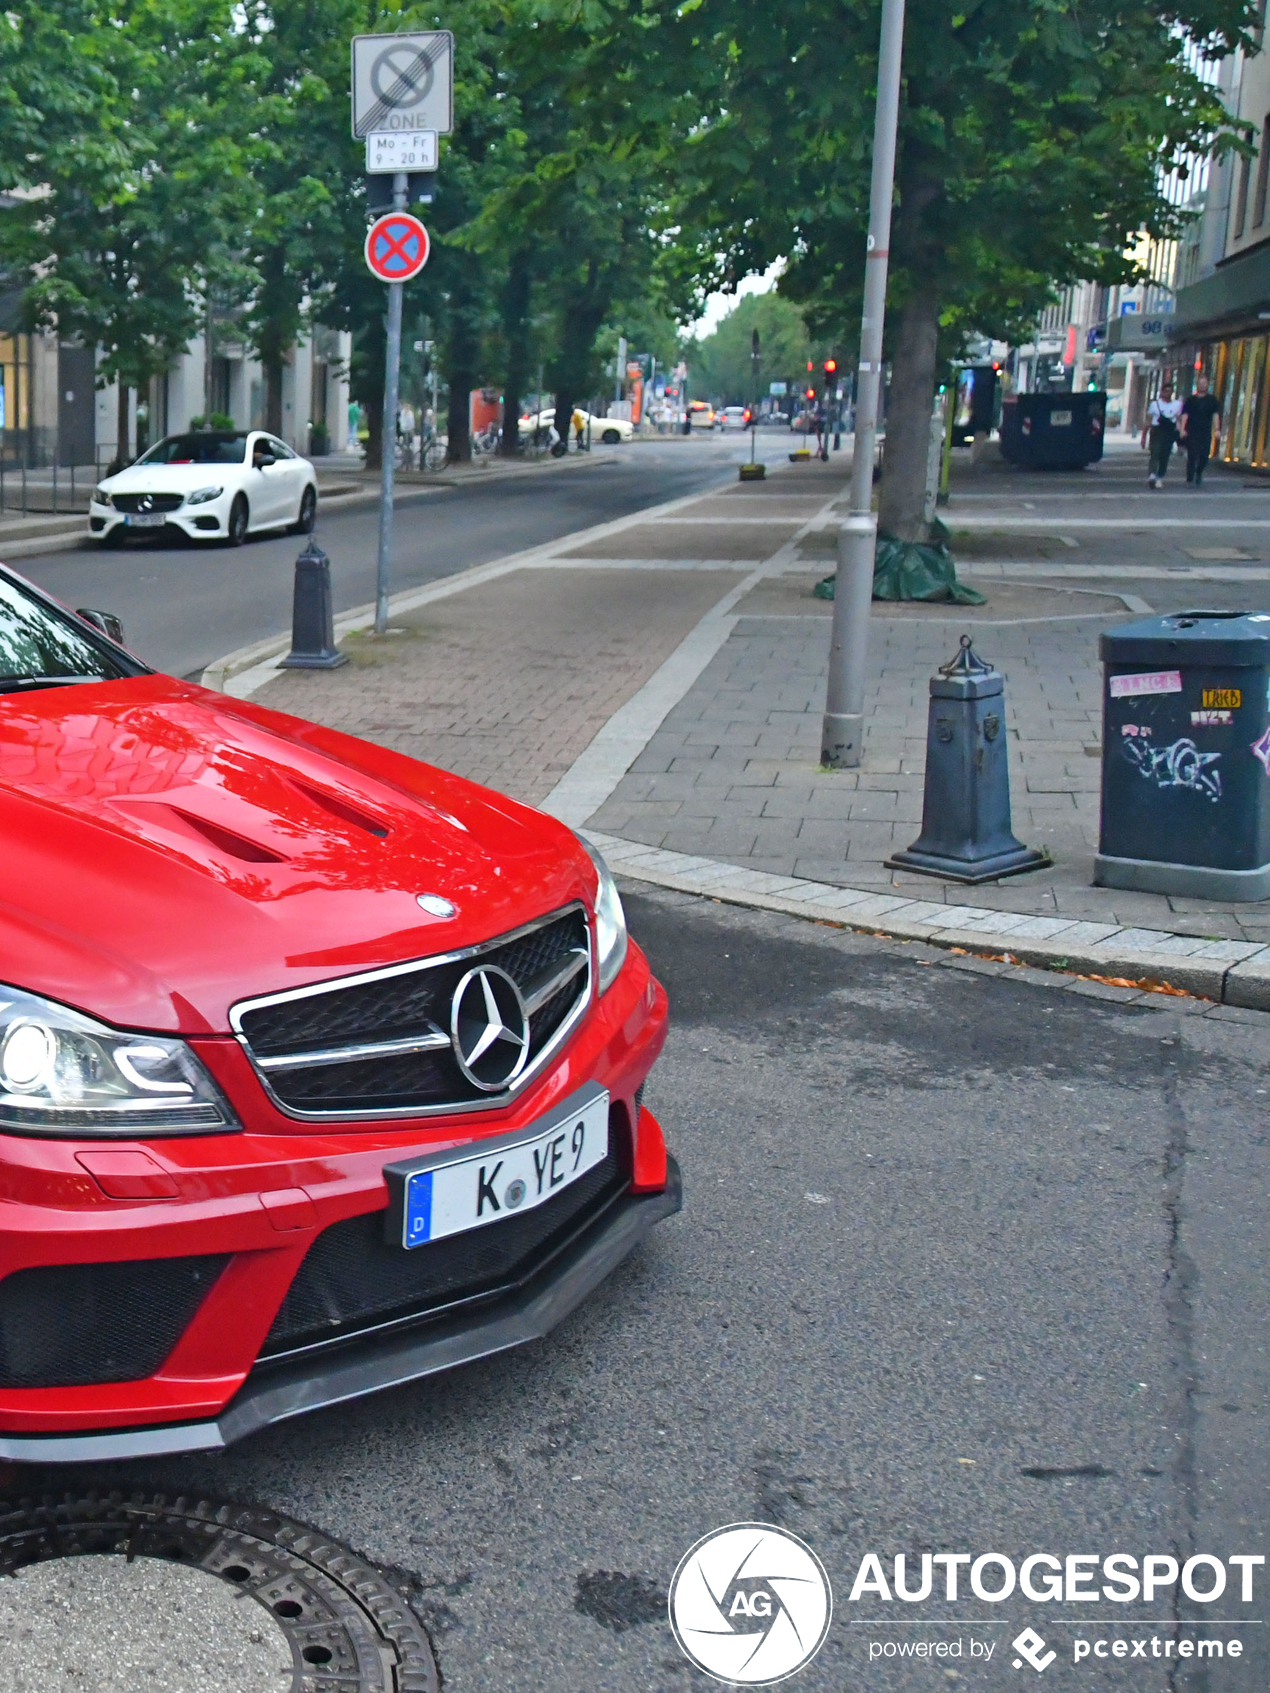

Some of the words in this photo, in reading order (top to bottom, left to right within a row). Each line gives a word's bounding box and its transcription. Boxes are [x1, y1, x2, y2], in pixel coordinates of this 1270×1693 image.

[379, 113, 427, 131] ZONE
[377, 138, 395, 149] Mo
[413, 136, 427, 147] Fr
[375, 153, 383, 165] 9
[401, 152, 416, 164] 20
[421, 152, 429, 163] h
[476, 1160, 504, 1217] K
[413, 1217, 425, 1232] D
